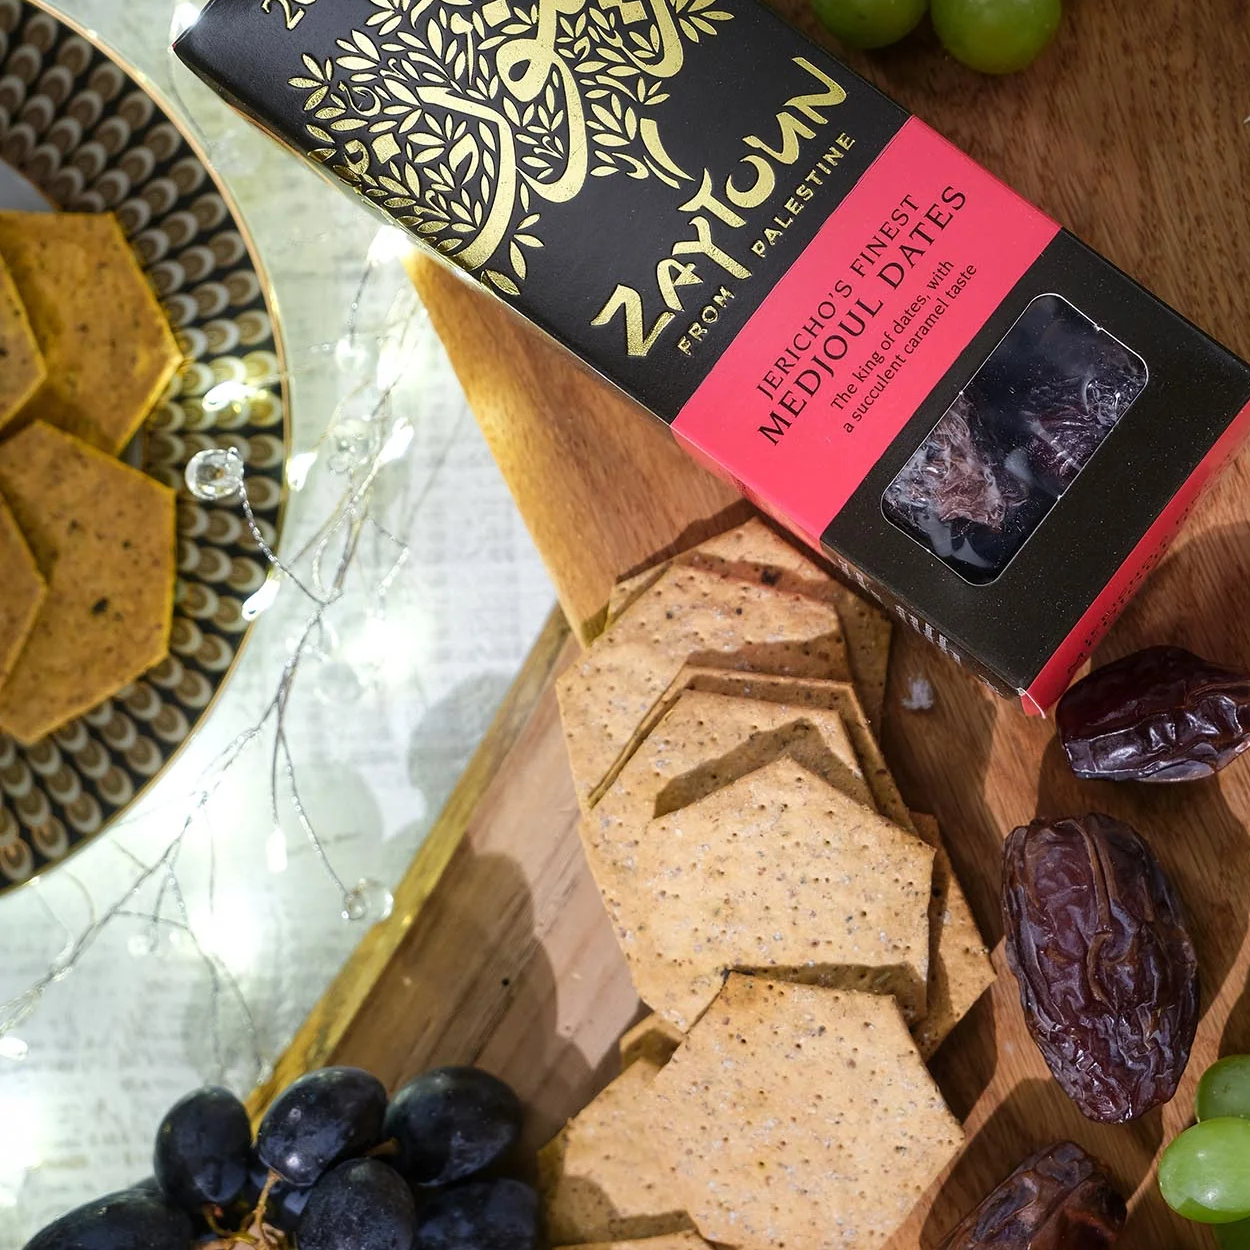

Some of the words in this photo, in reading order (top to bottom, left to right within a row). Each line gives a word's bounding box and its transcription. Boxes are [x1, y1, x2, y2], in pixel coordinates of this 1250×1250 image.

[590, 56, 847, 356] ZAYTOUN
[677, 285, 735, 355] FROM
[751, 132, 856, 257] PALESTINE
[756, 279, 852, 400] JERICHO'S
[849, 193, 919, 278] FINEST
[757, 297, 884, 446] MEDJOUL
[876, 185, 966, 289] DATES
[830, 383, 858, 409] The
[851, 350, 885, 382] king
[880, 330, 895, 350] of
[893, 294, 931, 334] dates,
[926, 261, 954, 289] with
[843, 422, 855, 433] a
[851, 353, 907, 421] succulent
[904, 297, 949, 354] caramel
[945, 264, 977, 299] taste
